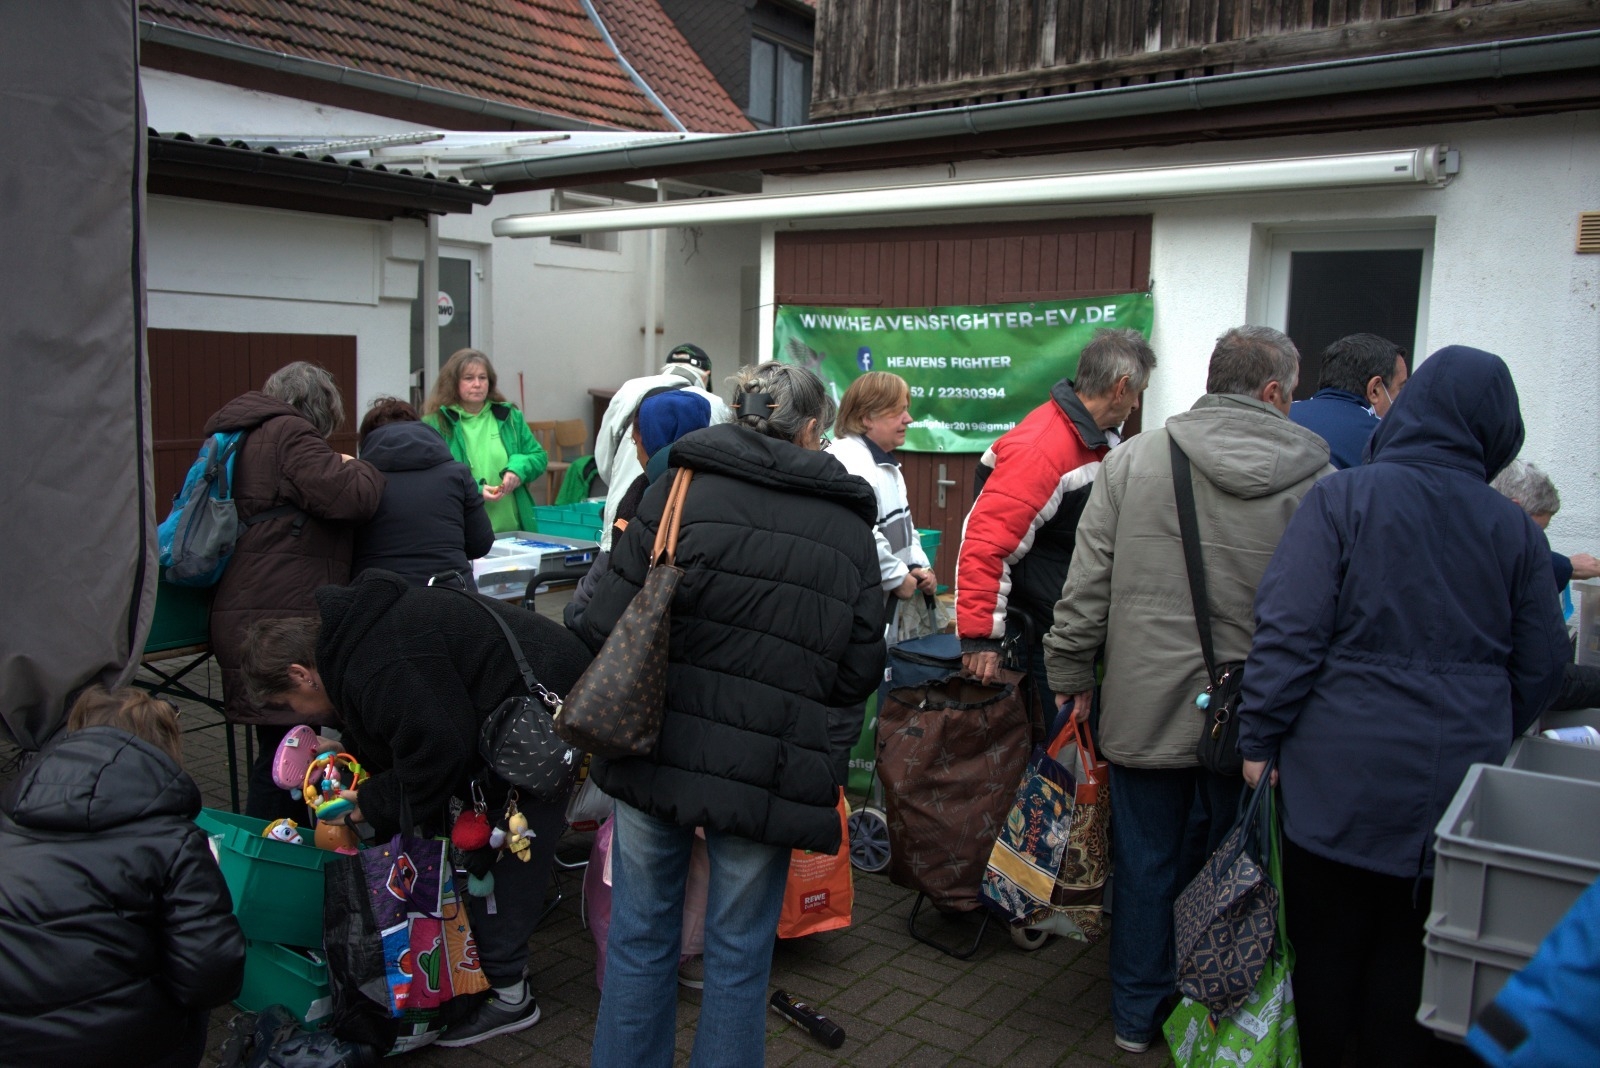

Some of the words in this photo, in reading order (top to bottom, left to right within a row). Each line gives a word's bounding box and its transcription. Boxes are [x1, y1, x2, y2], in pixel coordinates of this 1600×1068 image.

[886, 356, 947, 369] HEAVENS
[951, 355, 1012, 369] FIGHTER
[910, 386, 925, 398] 52
[938, 387, 1007, 400] 22330394
[906, 418, 1017, 433] ensfighter2019@gmail
[848, 758, 877, 772] sfig
[804, 892, 826, 904] REWE
